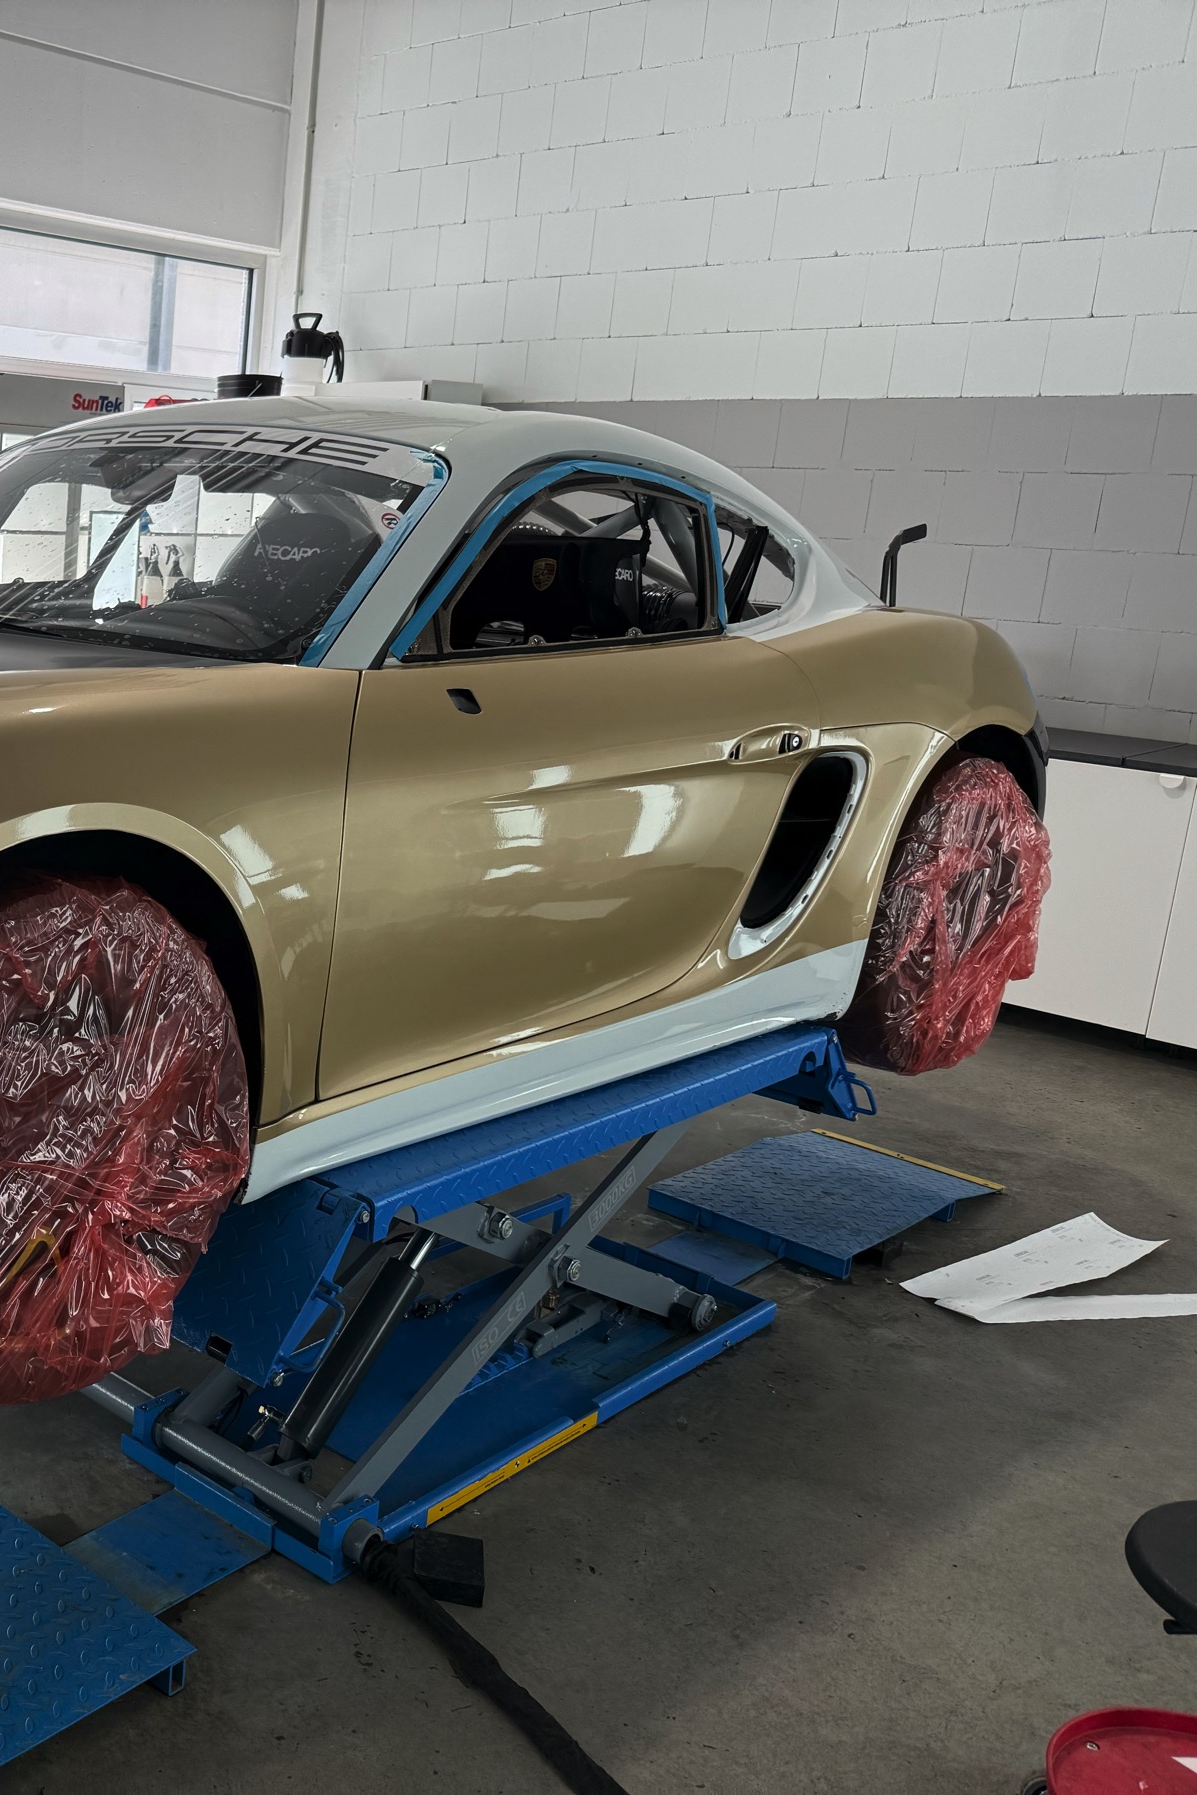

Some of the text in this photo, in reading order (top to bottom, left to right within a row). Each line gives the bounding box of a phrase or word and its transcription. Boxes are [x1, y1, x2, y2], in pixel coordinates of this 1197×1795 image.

[71, 393, 123, 413] SunTek
[24, 429, 390, 466] ORSCHE
[592, 1171, 633, 1227] 3000KG
[475, 1327, 499, 1359] ISO
